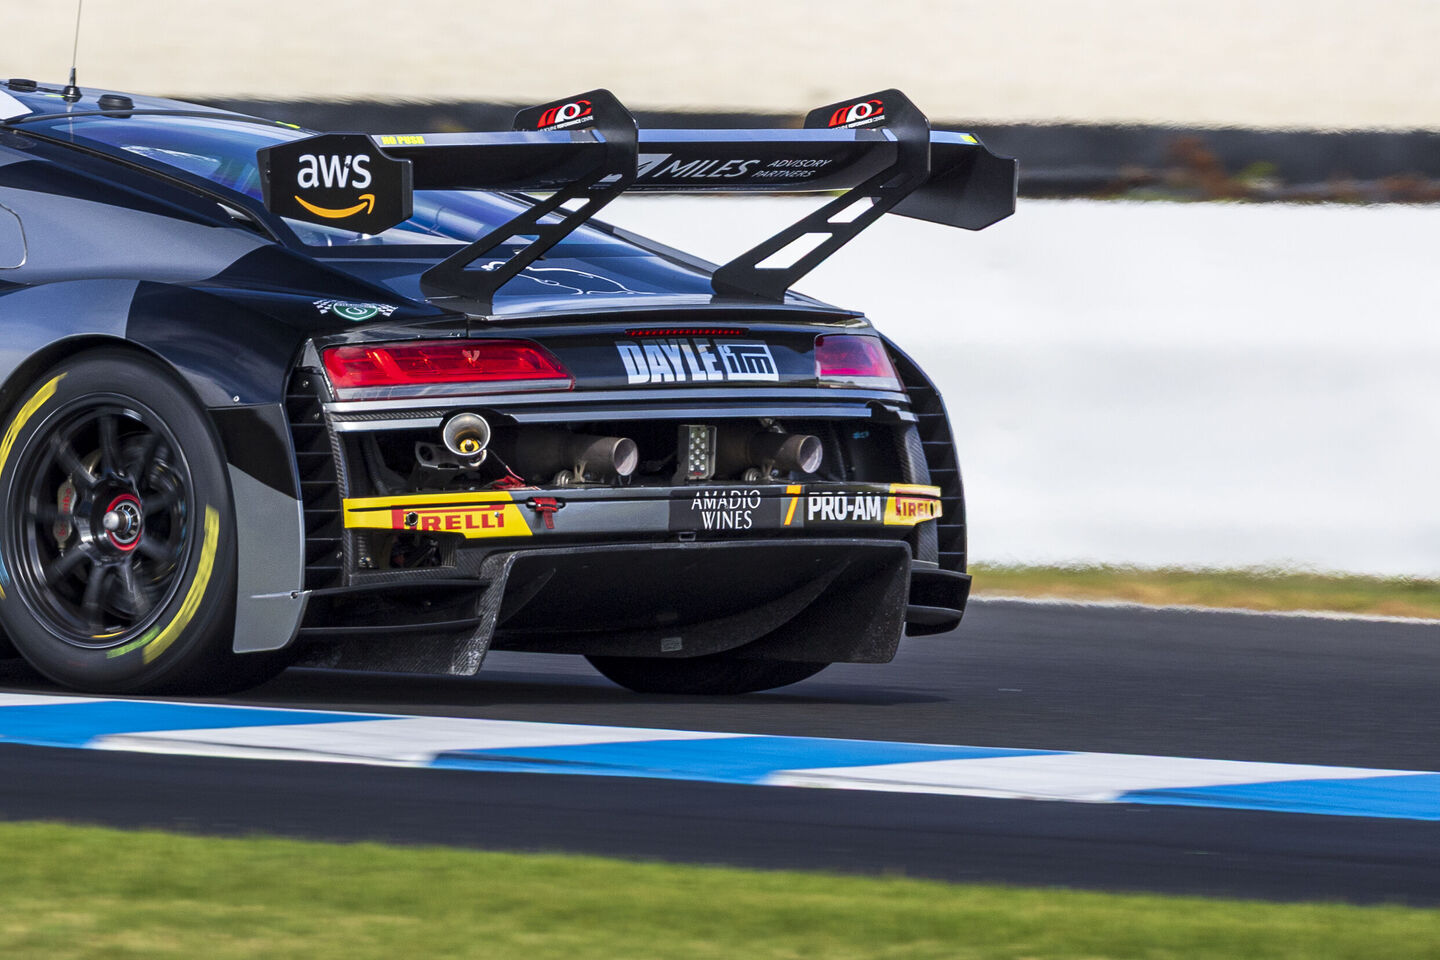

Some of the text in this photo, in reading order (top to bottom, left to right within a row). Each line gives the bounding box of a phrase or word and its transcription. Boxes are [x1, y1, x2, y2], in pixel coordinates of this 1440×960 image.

[381, 135, 425, 145] NO PUSH
[297, 154, 372, 189] aws
[654, 159, 761, 178] MILES
[767, 159, 832, 168] ADVISORY
[751, 170, 817, 178] PARTNERS
[614, 339, 724, 385] DAYLE
[691, 490, 762, 511] AMADIO
[784, 485, 802, 526] 7
[808, 492, 881, 521] PRO-AM
[701, 510, 753, 529] WINES
